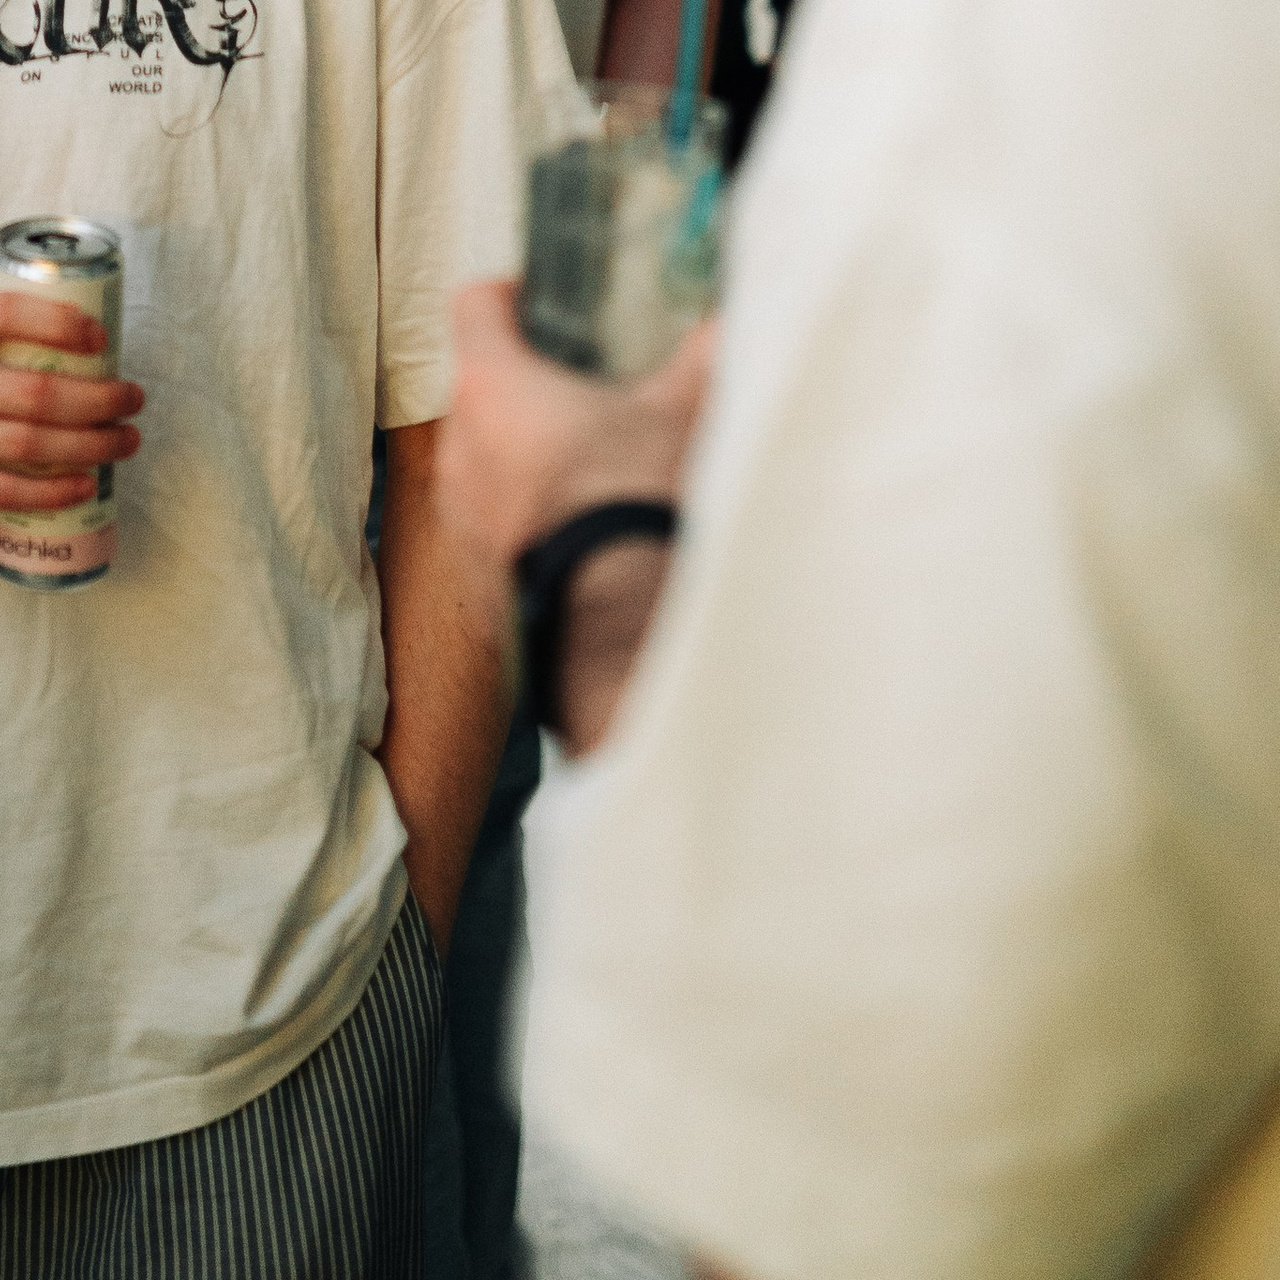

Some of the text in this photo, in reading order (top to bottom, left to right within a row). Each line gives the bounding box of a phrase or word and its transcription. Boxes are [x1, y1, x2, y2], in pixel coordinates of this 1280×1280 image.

[20, 68, 42, 83] ON
[131, 63, 163, 77] OUR
[108, 80, 163, 95] WORLD
